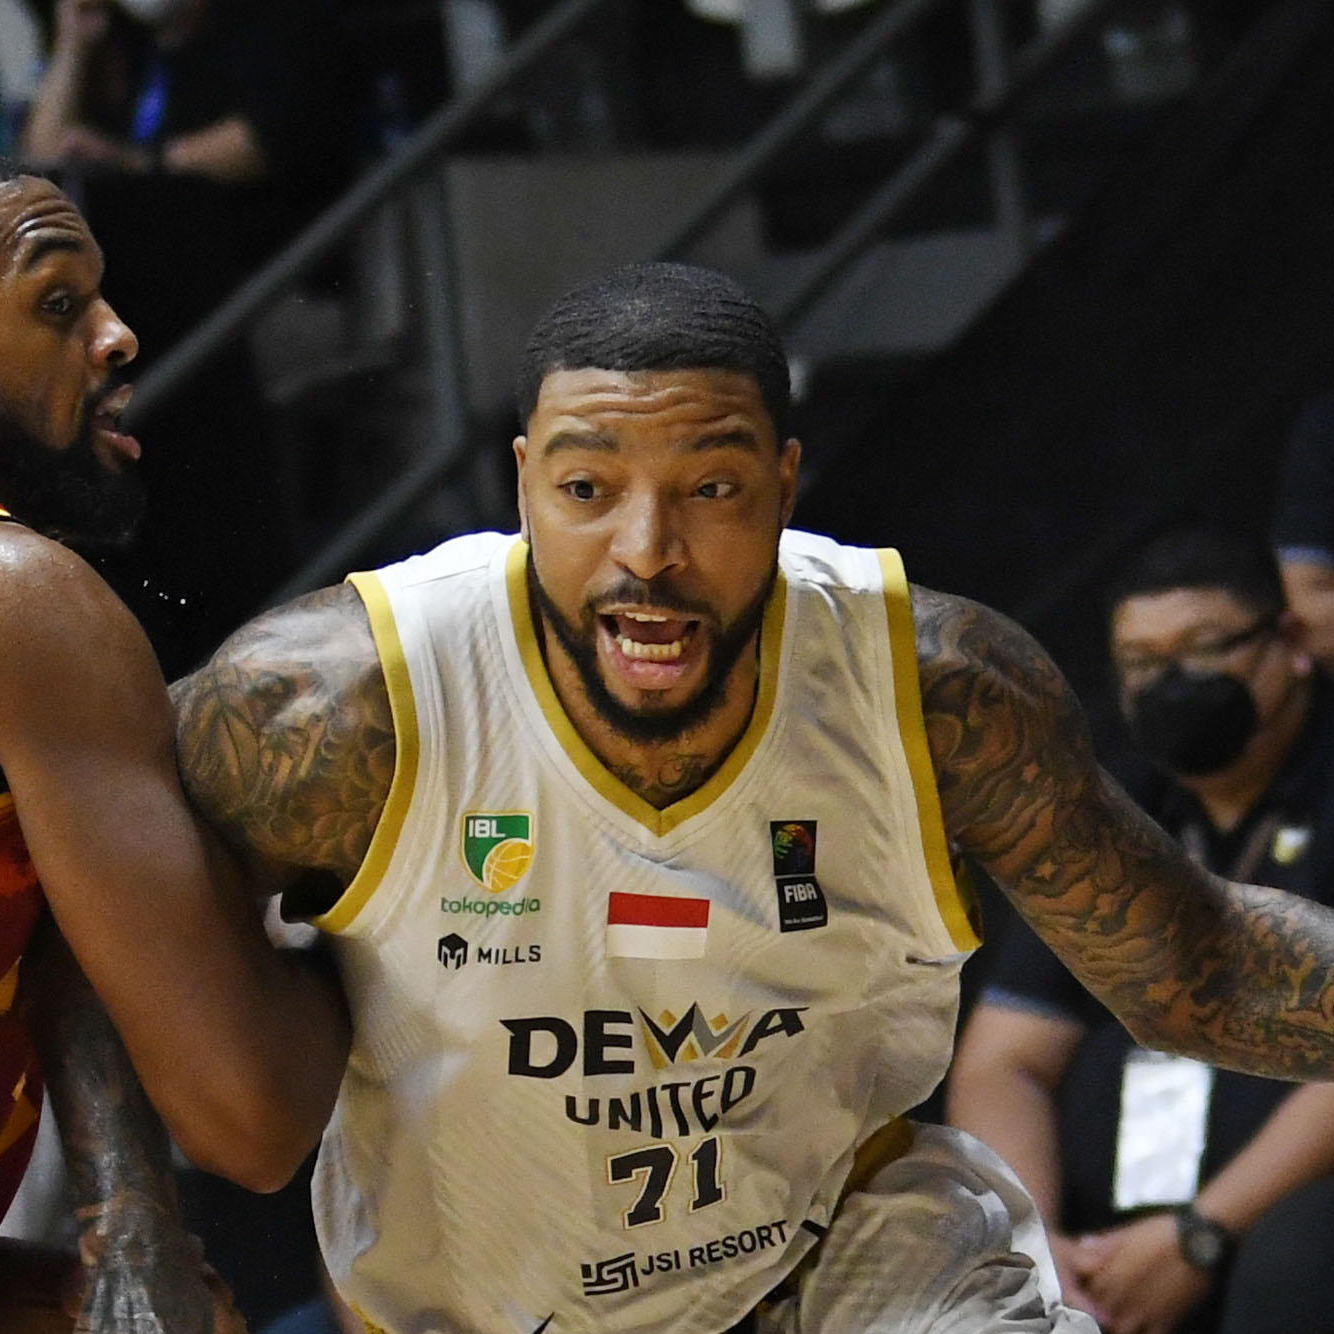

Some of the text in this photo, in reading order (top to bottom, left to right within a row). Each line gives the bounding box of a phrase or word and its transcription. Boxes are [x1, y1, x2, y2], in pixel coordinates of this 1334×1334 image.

[468, 819, 507, 838] IBL
[440, 897, 542, 918] tokopedia
[783, 882, 818, 904] FIBA
[477, 944, 542, 965] MILLS
[499, 1000, 810, 1079] DEWA
[565, 1065, 757, 1139] UNITED
[606, 1134, 727, 1231] 71
[640, 1250, 682, 1276] JSI
[689, 1219, 788, 1268] RESORT
